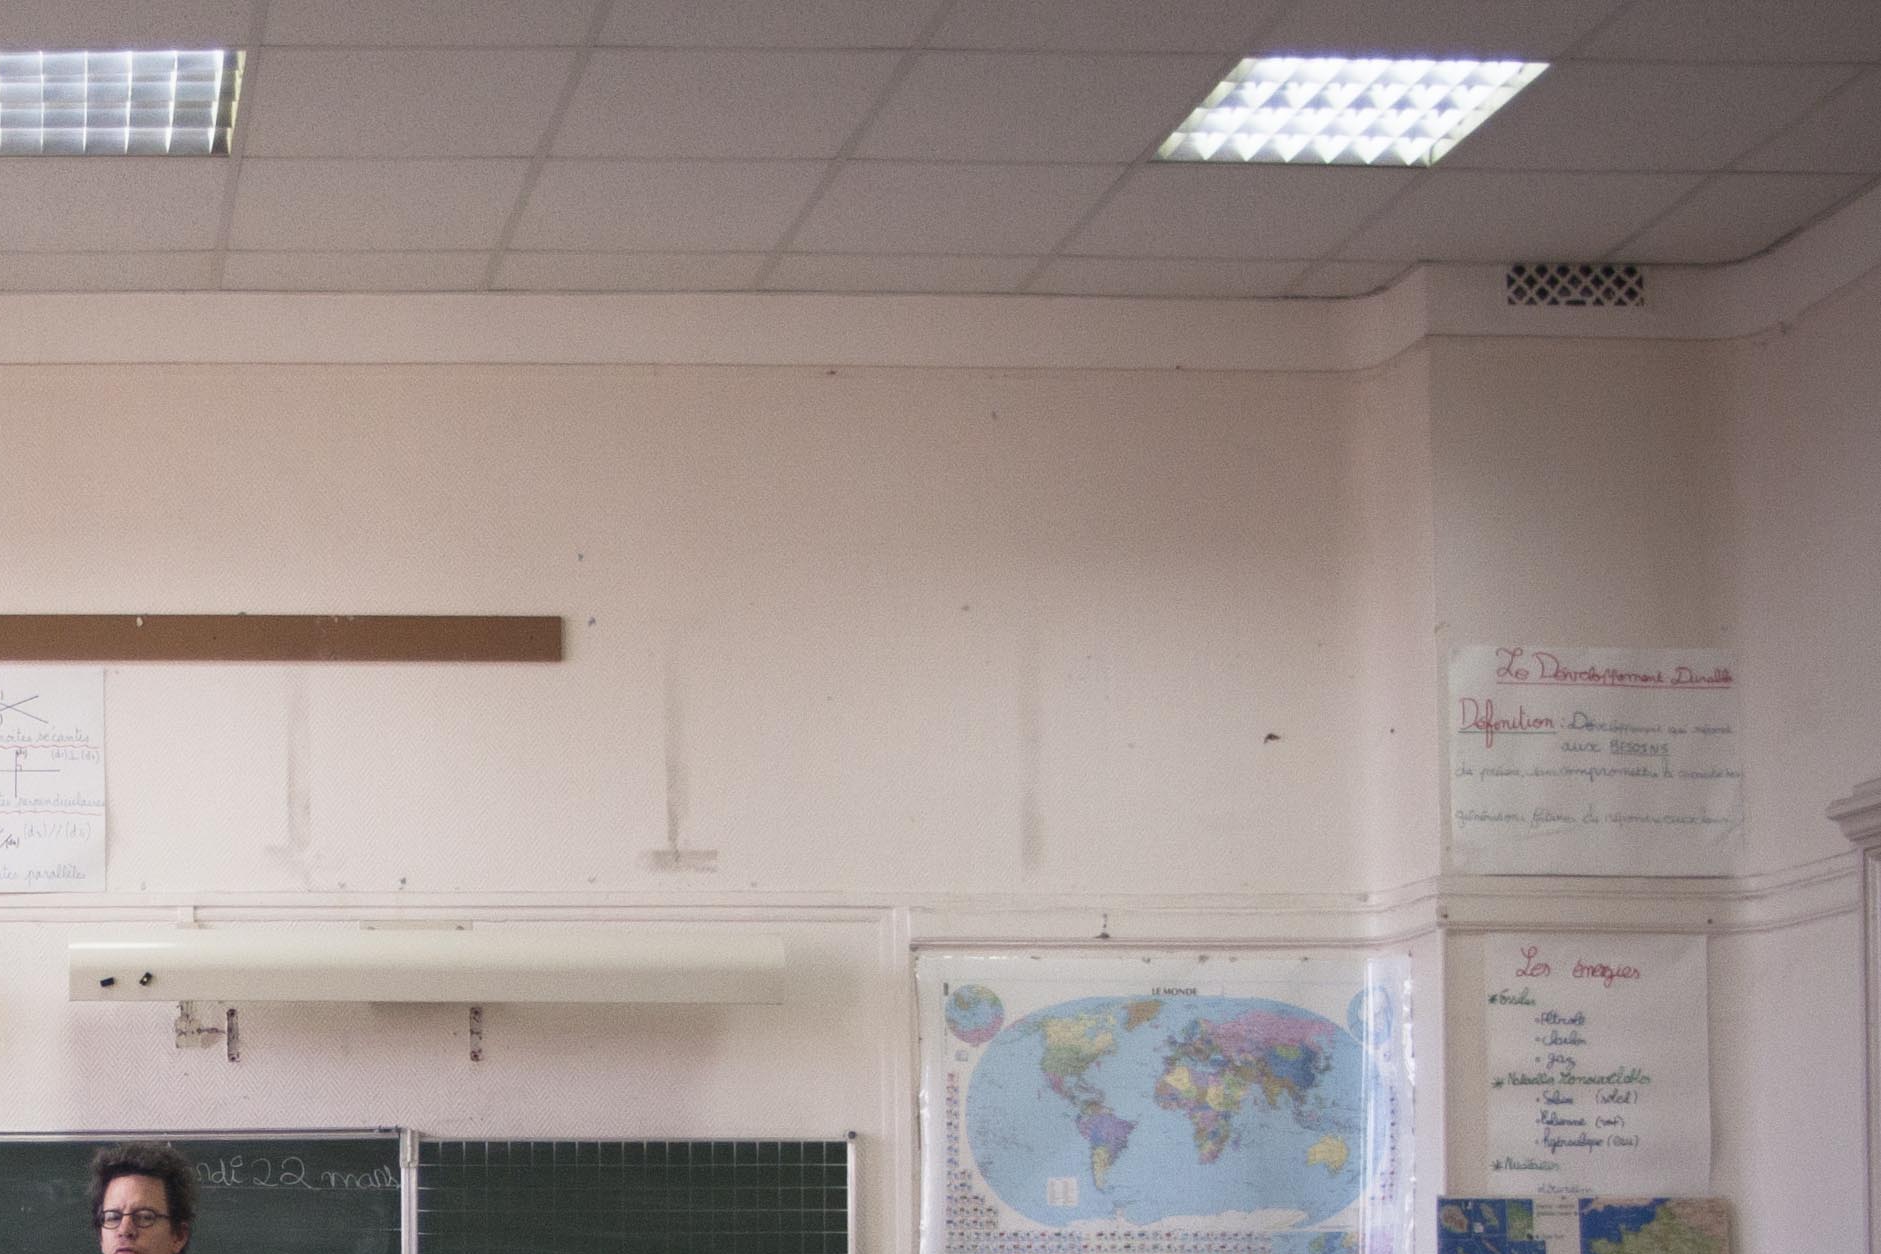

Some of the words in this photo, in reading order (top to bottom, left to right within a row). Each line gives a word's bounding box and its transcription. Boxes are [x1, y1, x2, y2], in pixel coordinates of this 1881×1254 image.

[1516, 946, 1551, 977] Les
[1151, 986, 1160, 996] LE
[1163, 986, 1197, 996] MONDE
[195, 1155, 243, 1187] ndi
[250, 1155, 322, 1190] 22
